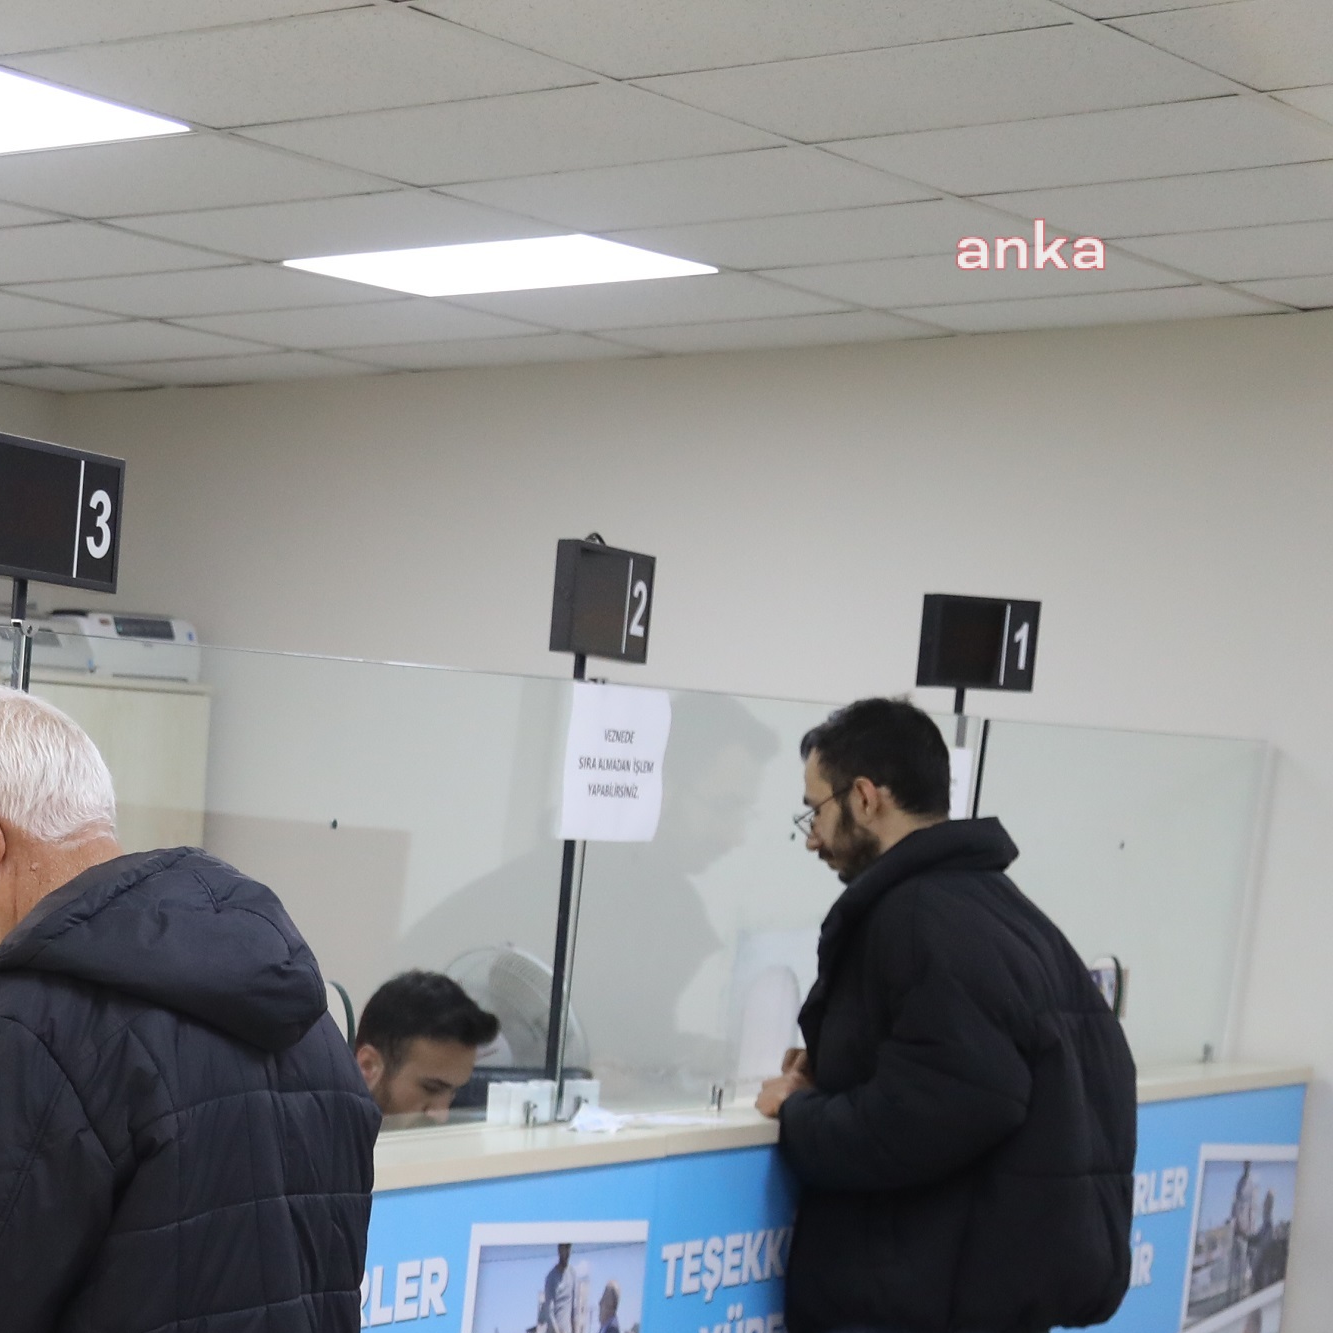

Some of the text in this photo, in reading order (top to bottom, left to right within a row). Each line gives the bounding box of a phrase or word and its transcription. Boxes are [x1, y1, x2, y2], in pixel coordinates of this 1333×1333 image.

[85, 489, 113, 559] 3
[628, 580, 649, 638] 2
[1014, 622, 1031, 671] 1
[604, 729, 635, 744] VEZNEDE
[578, 756, 596, 770] SIRA
[598, 758, 631, 772] ALMADAN
